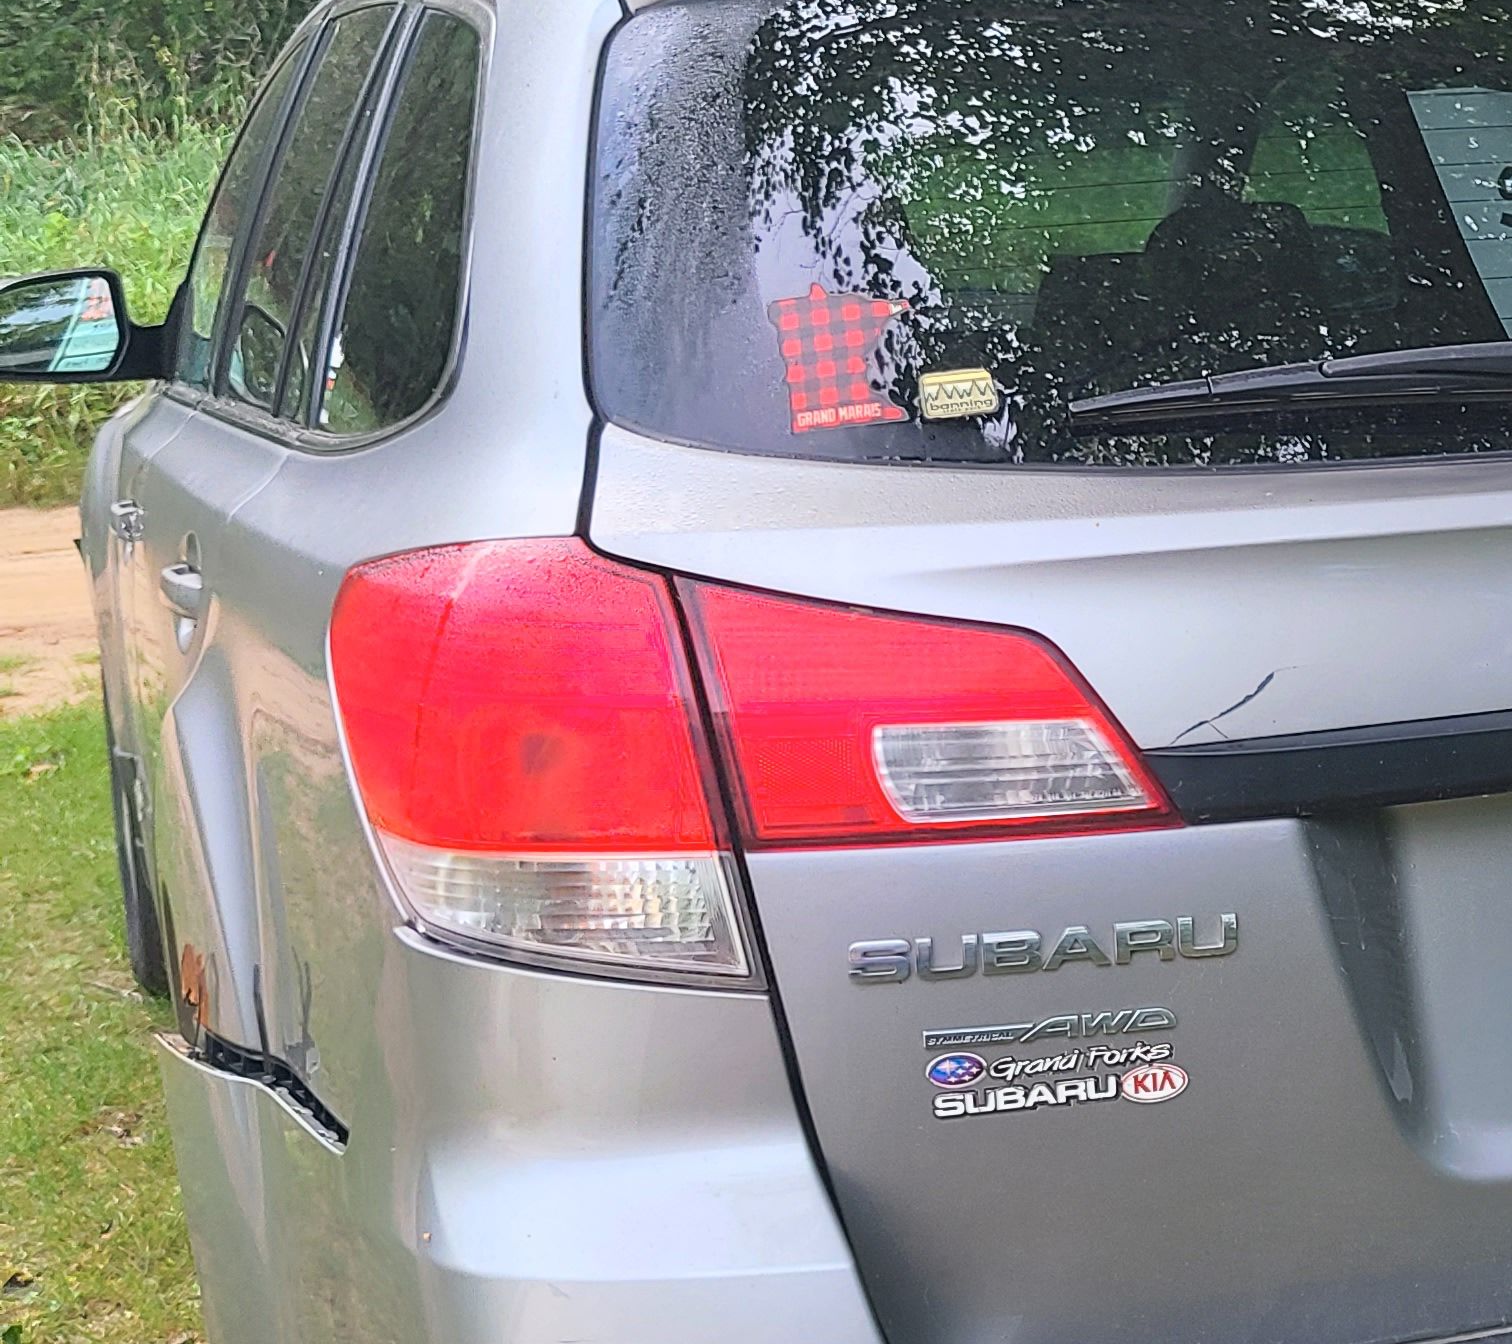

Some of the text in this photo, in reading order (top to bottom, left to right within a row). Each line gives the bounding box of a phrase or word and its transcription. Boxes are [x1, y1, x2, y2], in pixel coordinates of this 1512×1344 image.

[797, 403, 882, 427] GRAND MARAIS
[930, 399, 993, 411] banning
[848, 912, 1238, 984] SUBARU
[1019, 1006, 1178, 1043] AWD
[988, 1042, 1172, 1081] Grand Forks
[934, 1074, 1117, 1118] SUBARU
[1132, 1071, 1178, 1096] KIA
